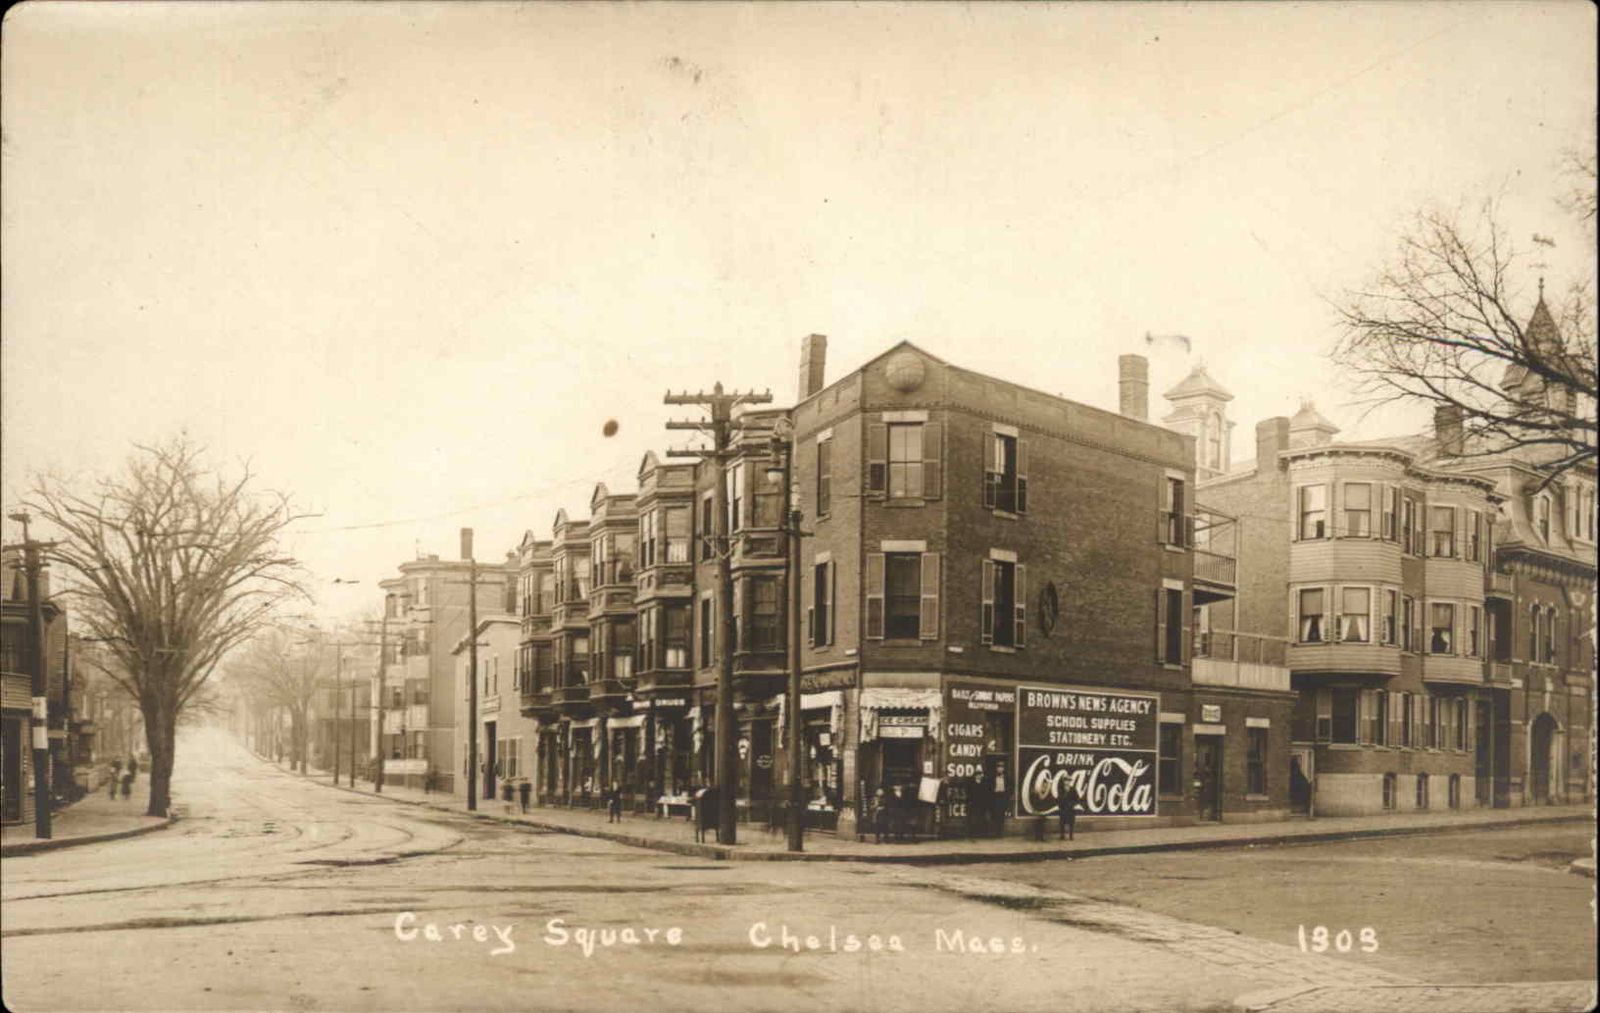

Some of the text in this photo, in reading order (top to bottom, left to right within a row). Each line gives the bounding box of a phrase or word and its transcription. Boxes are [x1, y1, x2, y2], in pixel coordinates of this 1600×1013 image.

[1027, 692, 1152, 715] BROWN'S NEWS AGENCY
[1046, 715, 1136, 731] SCHOOL SUPPLIES
[948, 723, 984, 738] CIGARS
[1049, 731, 1133, 746] STATIONERY ETC.
[949, 744, 983, 757] CANDY
[1056, 753, 1094, 766] DRINK
[947, 763, 984, 777] SODA
[948, 804, 967, 817] ICE
